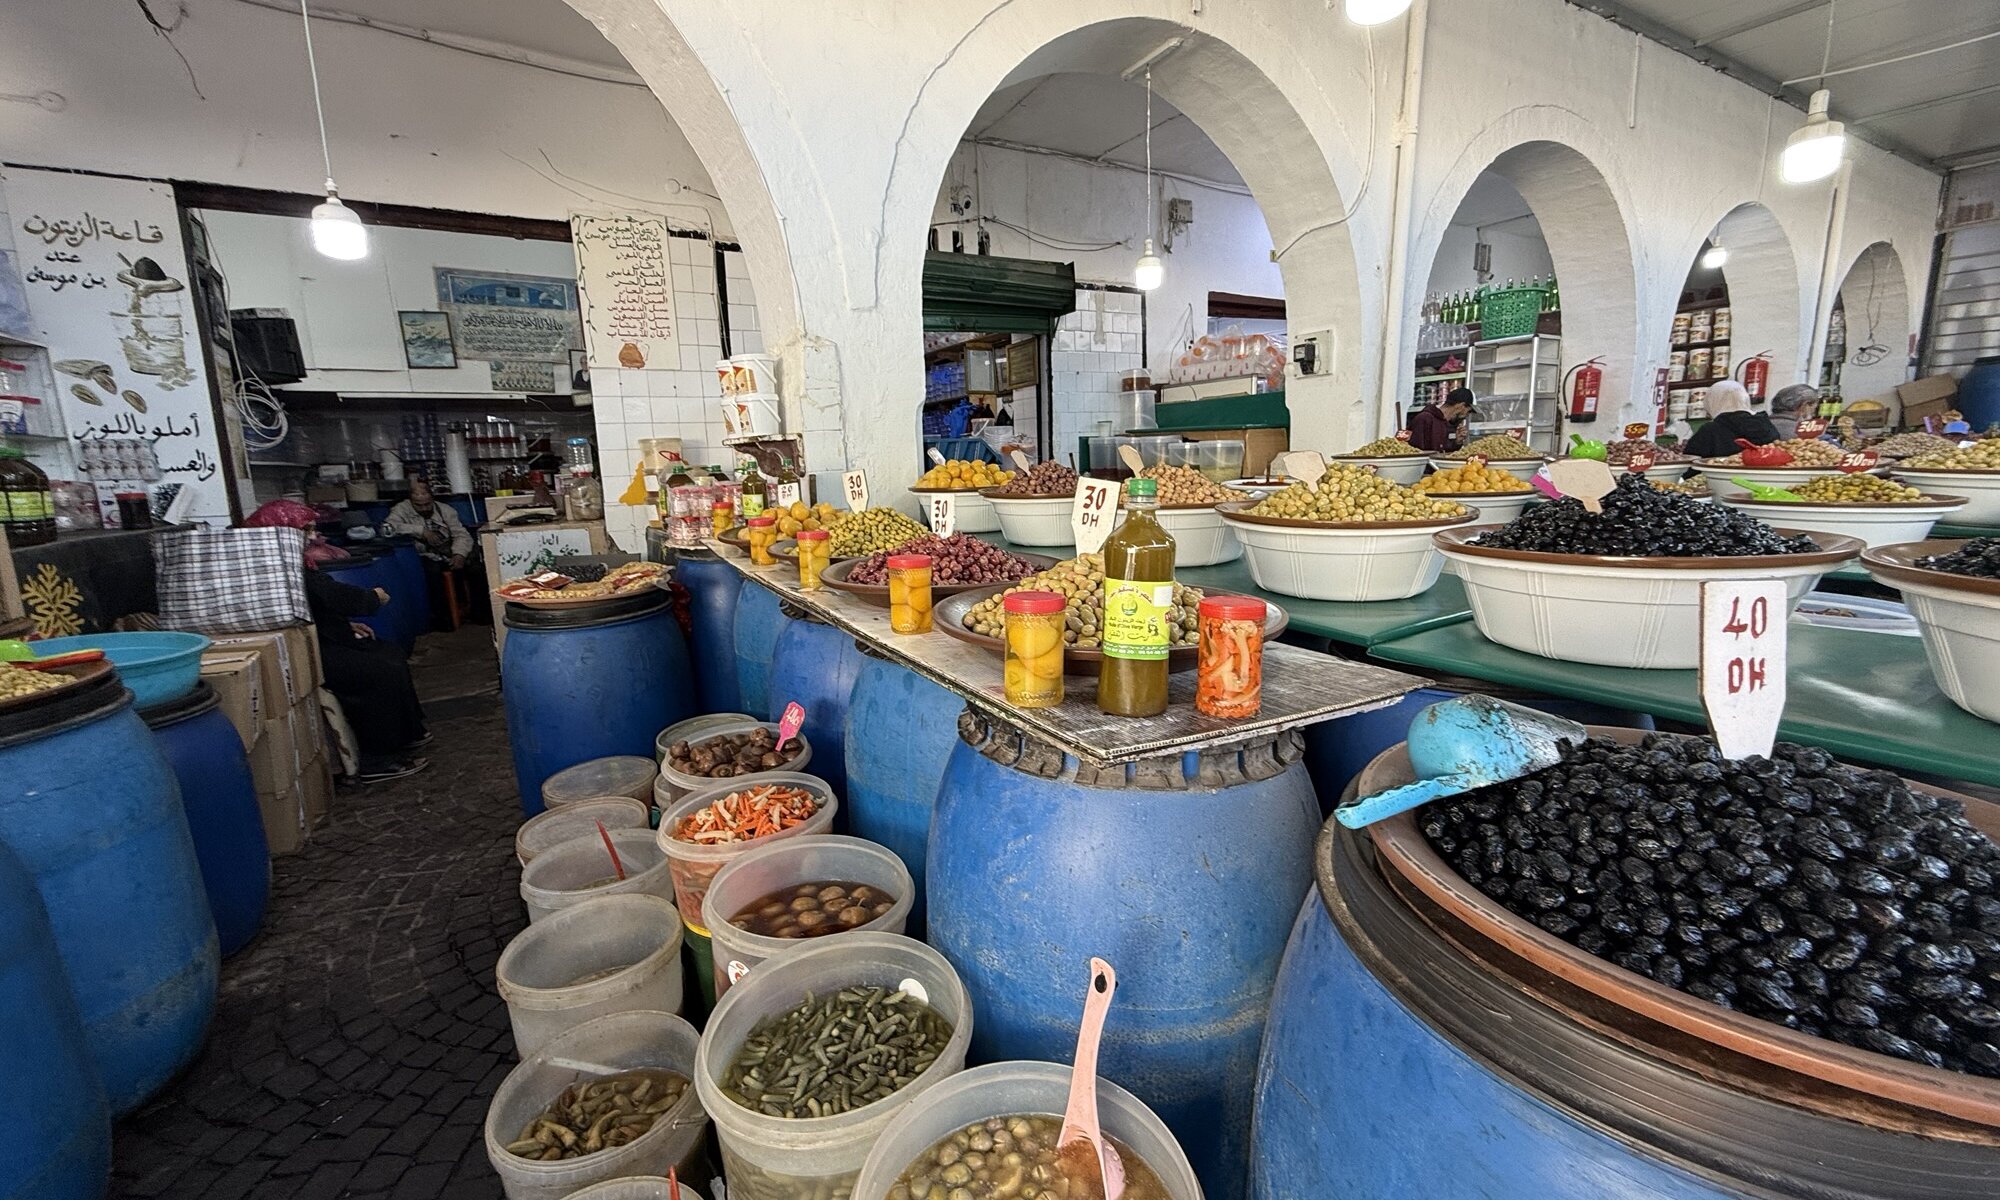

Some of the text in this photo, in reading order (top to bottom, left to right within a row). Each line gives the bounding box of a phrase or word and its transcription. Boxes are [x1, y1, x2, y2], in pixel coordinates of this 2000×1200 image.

[23, 211, 164, 248] قاعة الزيتون
[45, 251, 82, 262] عند
[82, 272, 107, 289] بن
[73, 412, 200, 443] أملو باللوز
[848, 474, 862, 489] 30
[851, 488, 864, 501] DH
[1083, 485, 1107, 511] 30
[934, 500, 948, 519] 30
[935, 520, 947, 533] DH
[1081, 512, 1099, 528] DH
[1722, 596, 1768, 640] 40
[1728, 657, 1768, 695] DH
